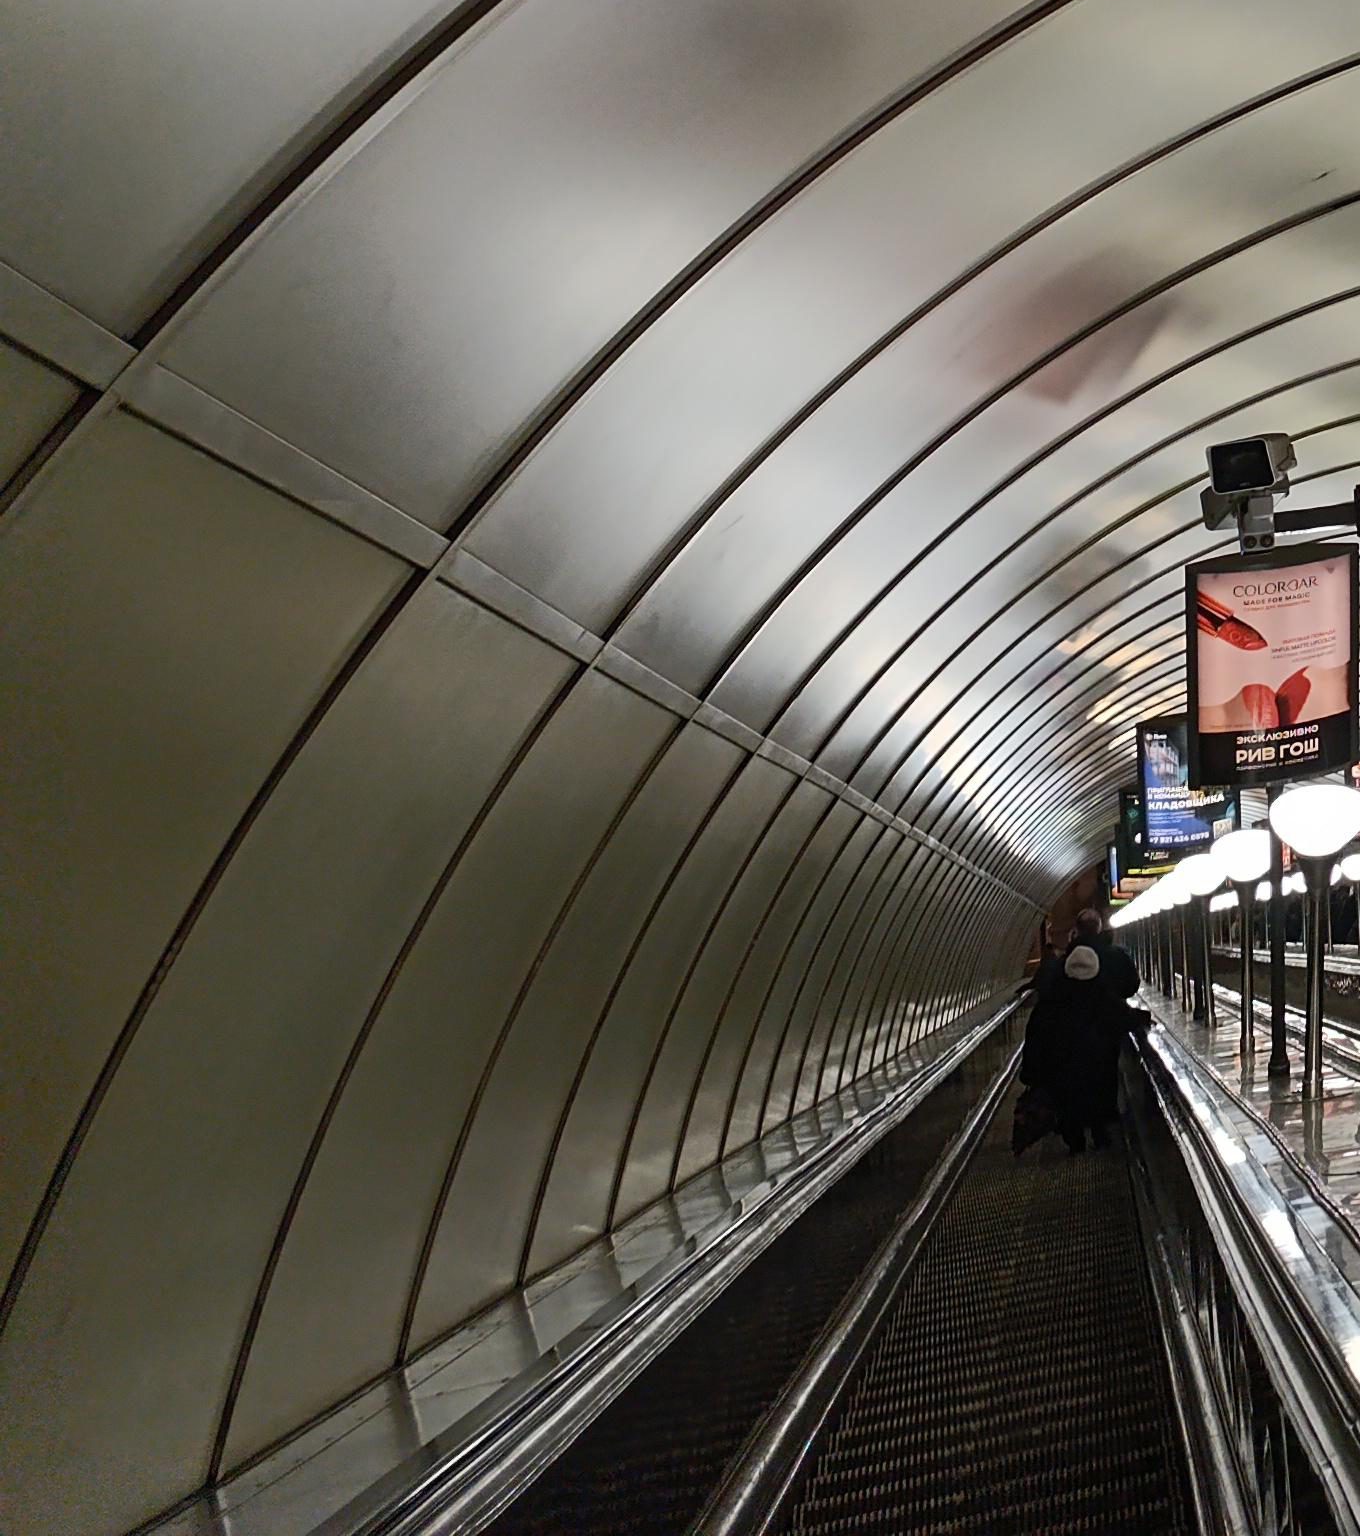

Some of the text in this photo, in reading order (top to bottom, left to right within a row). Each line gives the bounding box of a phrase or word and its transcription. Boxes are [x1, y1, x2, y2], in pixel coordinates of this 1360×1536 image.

[1243, 598, 1266, 606] MADE
[1284, 592, 1310, 601] MAGIC
[1236, 724, 1319, 744] ЭКСКЛЮЗИВНО
[1236, 746, 1275, 764] РИВ
[1280, 737, 1319, 758] ГОШ
[1148, 794, 1225, 810] КЛАДОВЩИКА
